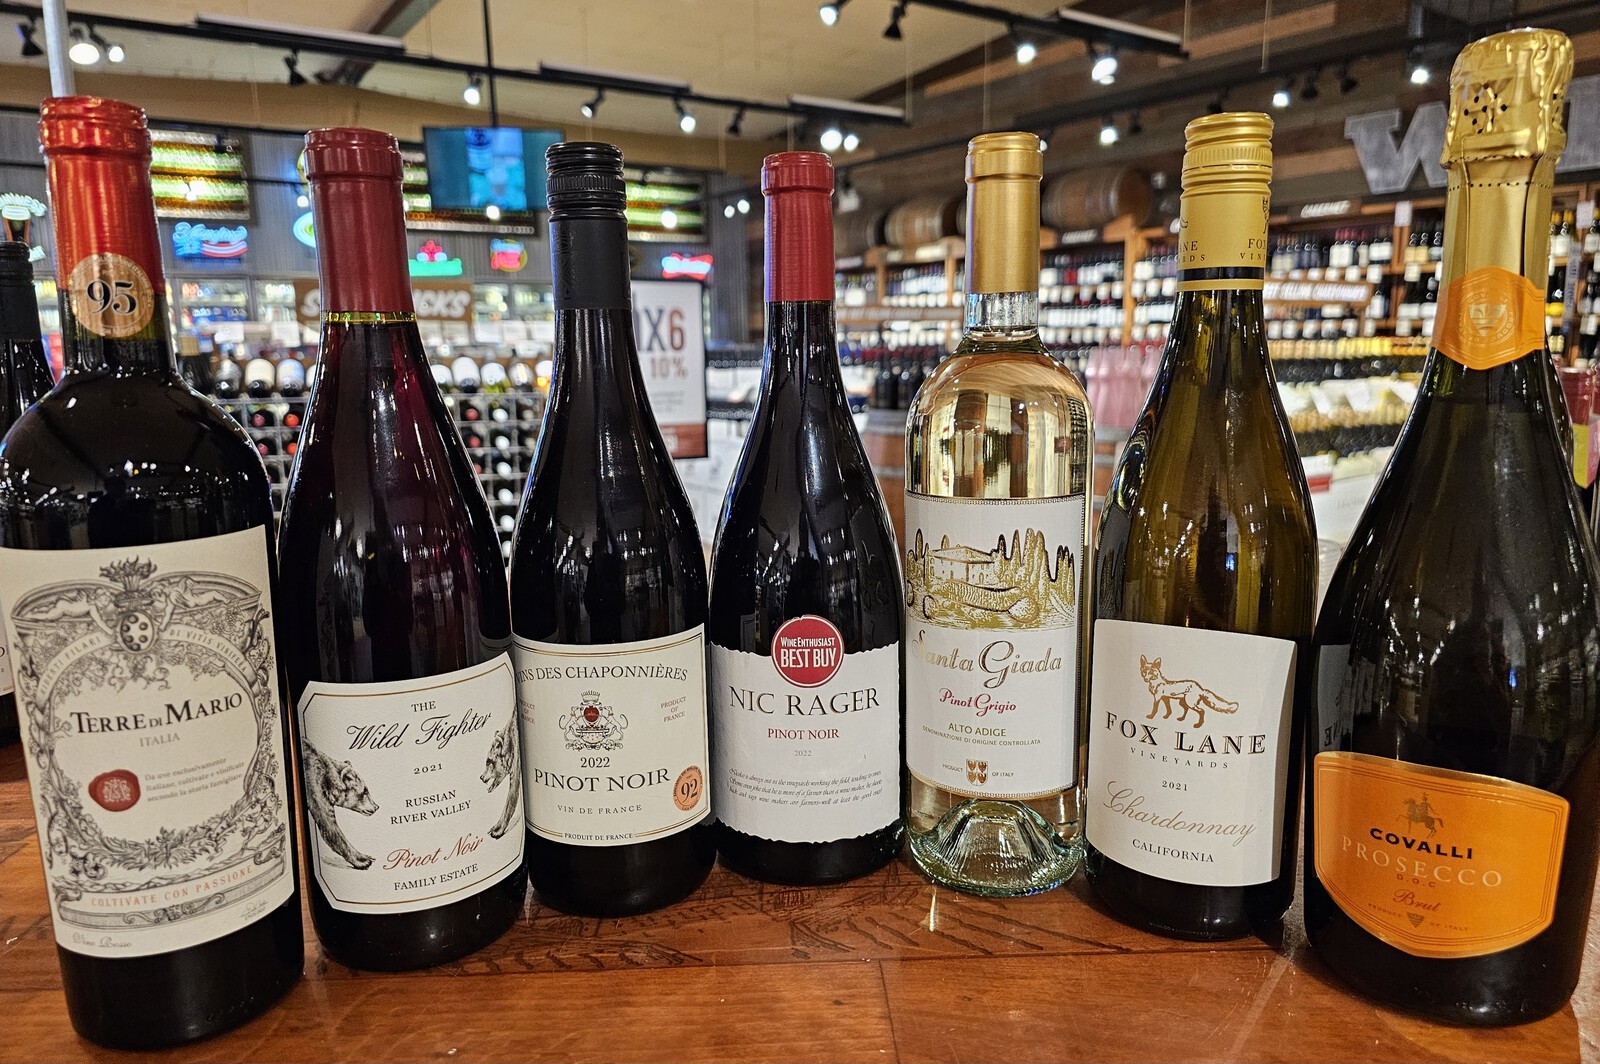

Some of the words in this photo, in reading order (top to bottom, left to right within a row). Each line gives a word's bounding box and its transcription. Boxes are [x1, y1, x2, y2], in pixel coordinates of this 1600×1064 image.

[86, 279, 137, 315] 95
[186, 630, 213, 646] VITIS
[780, 648, 812, 668] BEST
[813, 647, 836, 667] BUY
[911, 629, 974, 672] Santa
[978, 640, 1063, 689] Giada
[536, 666, 562, 680] DES
[565, 663, 688, 681] CHAPONNIÈRES
[411, 700, 437, 713] THE
[660, 696, 686, 708] PRODUCT
[729, 686, 775, 714] NIC
[785, 687, 880, 716] RAGER
[939, 687, 973, 708] Pinot
[974, 693, 1017, 717] Grigio
[69, 711, 147, 734] TERRE
[165, 692, 243, 725] MARIO
[663, 711, 686, 722] FRANCE
[139, 732, 181, 748] ITALIA
[346, 722, 410, 750] Wild
[415, 708, 493, 750] Fighter
[767, 728, 805, 740] PINOT
[807, 728, 840, 740] NOIR
[922, 725, 962, 741] DENOMINAZIONE
[972, 738, 997, 746] ORIGINE
[948, 722, 973, 735] ALTO
[975, 727, 1007, 737] ADIGE
[1105, 710, 1159, 746] FOX
[1174, 731, 1267, 755] LANE
[580, 756, 611, 768] 2022
[794, 749, 812, 757] 2022
[1130, 747, 1229, 769] VINEYARDS
[413, 763, 443, 775] 2021
[534, 767, 600, 792] PINOT
[606, 768, 671, 792] NOIR
[681, 778, 698, 803] 92
[1162, 779, 1189, 791] 2021
[405, 789, 457, 808] RUSSIAN
[557, 804, 574, 813] VIN
[579, 807, 593, 815] DE
[598, 804, 642, 814] FRANCE
[390, 811, 428, 825] RIVER
[430, 800, 472, 818] VALLEY
[1102, 780, 1256, 847] Chardonnay
[564, 833, 593, 841] PRODUIT
[605, 832, 634, 841] FRANCE
[1370, 827, 1473, 859] COVALLI
[382, 848, 441, 871] Pinot
[443, 832, 485, 861] Noir
[1132, 838, 1215, 863] CALIFORNIA
[1342, 835, 1502, 888] PROSECCO
[91, 893, 158, 908] COLTIVATE
[164, 888, 189, 900] CON
[195, 865, 253, 893] PASSIONE
[393, 876, 437, 891] FAMILY
[440, 863, 479, 883] ESTATE
[1392, 888, 1441, 912] Brut
